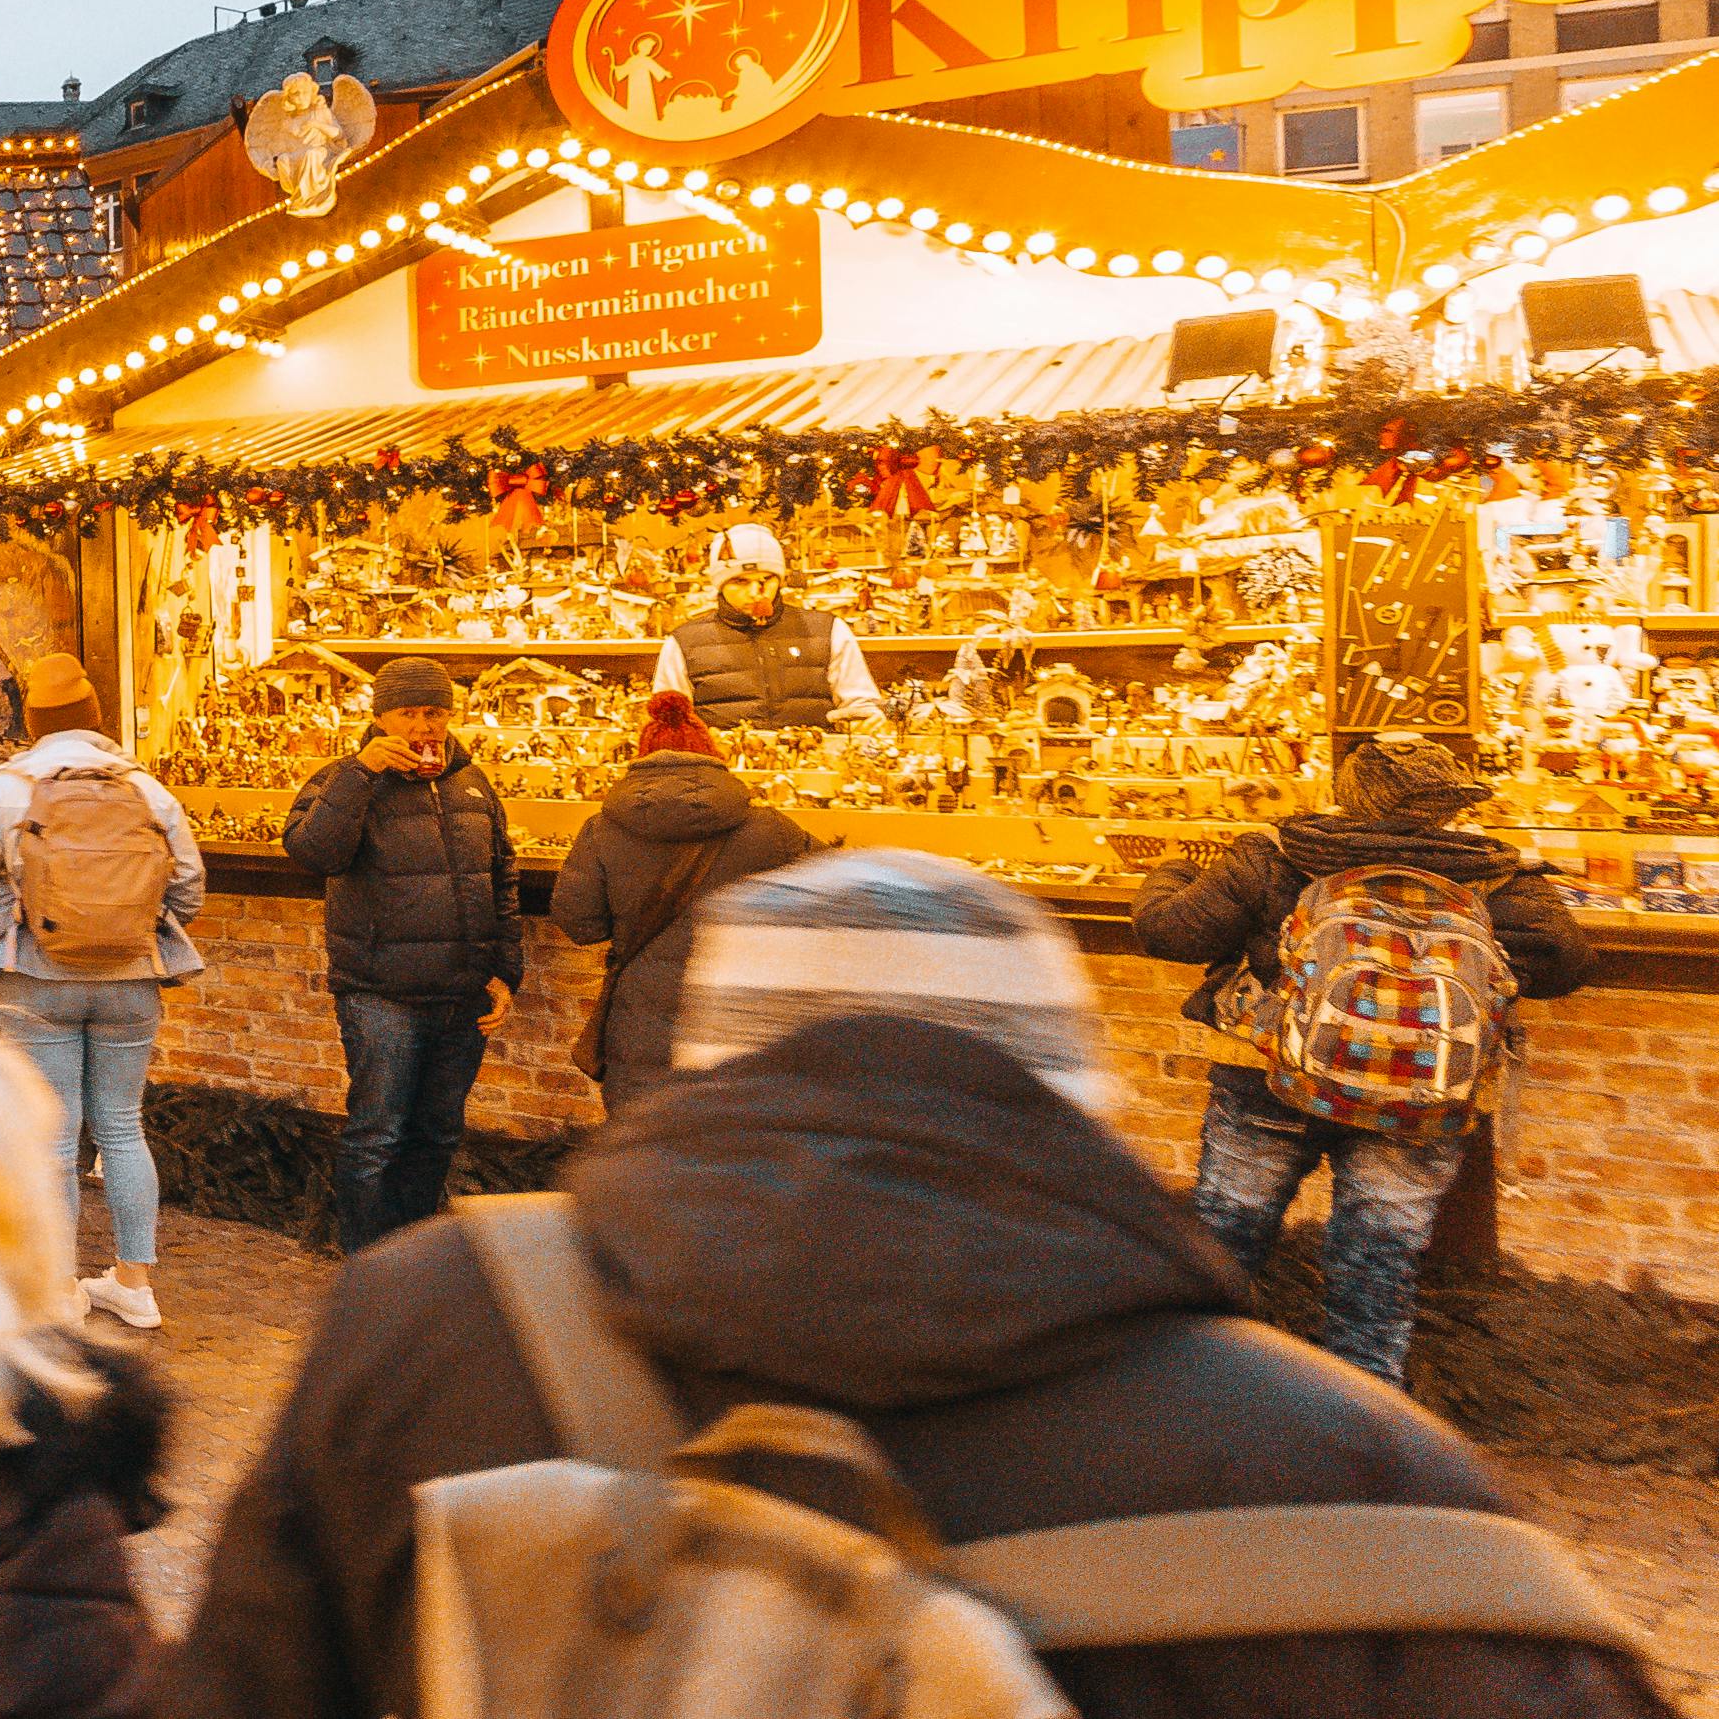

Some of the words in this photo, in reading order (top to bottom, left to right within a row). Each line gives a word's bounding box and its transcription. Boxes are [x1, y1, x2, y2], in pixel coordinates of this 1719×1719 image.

[459, 253, 591, 293] Krippen
[627, 234, 768, 274] Figuren
[458, 276, 771, 333] Räuchermännchen
[505, 327, 719, 370] Nussknacker
